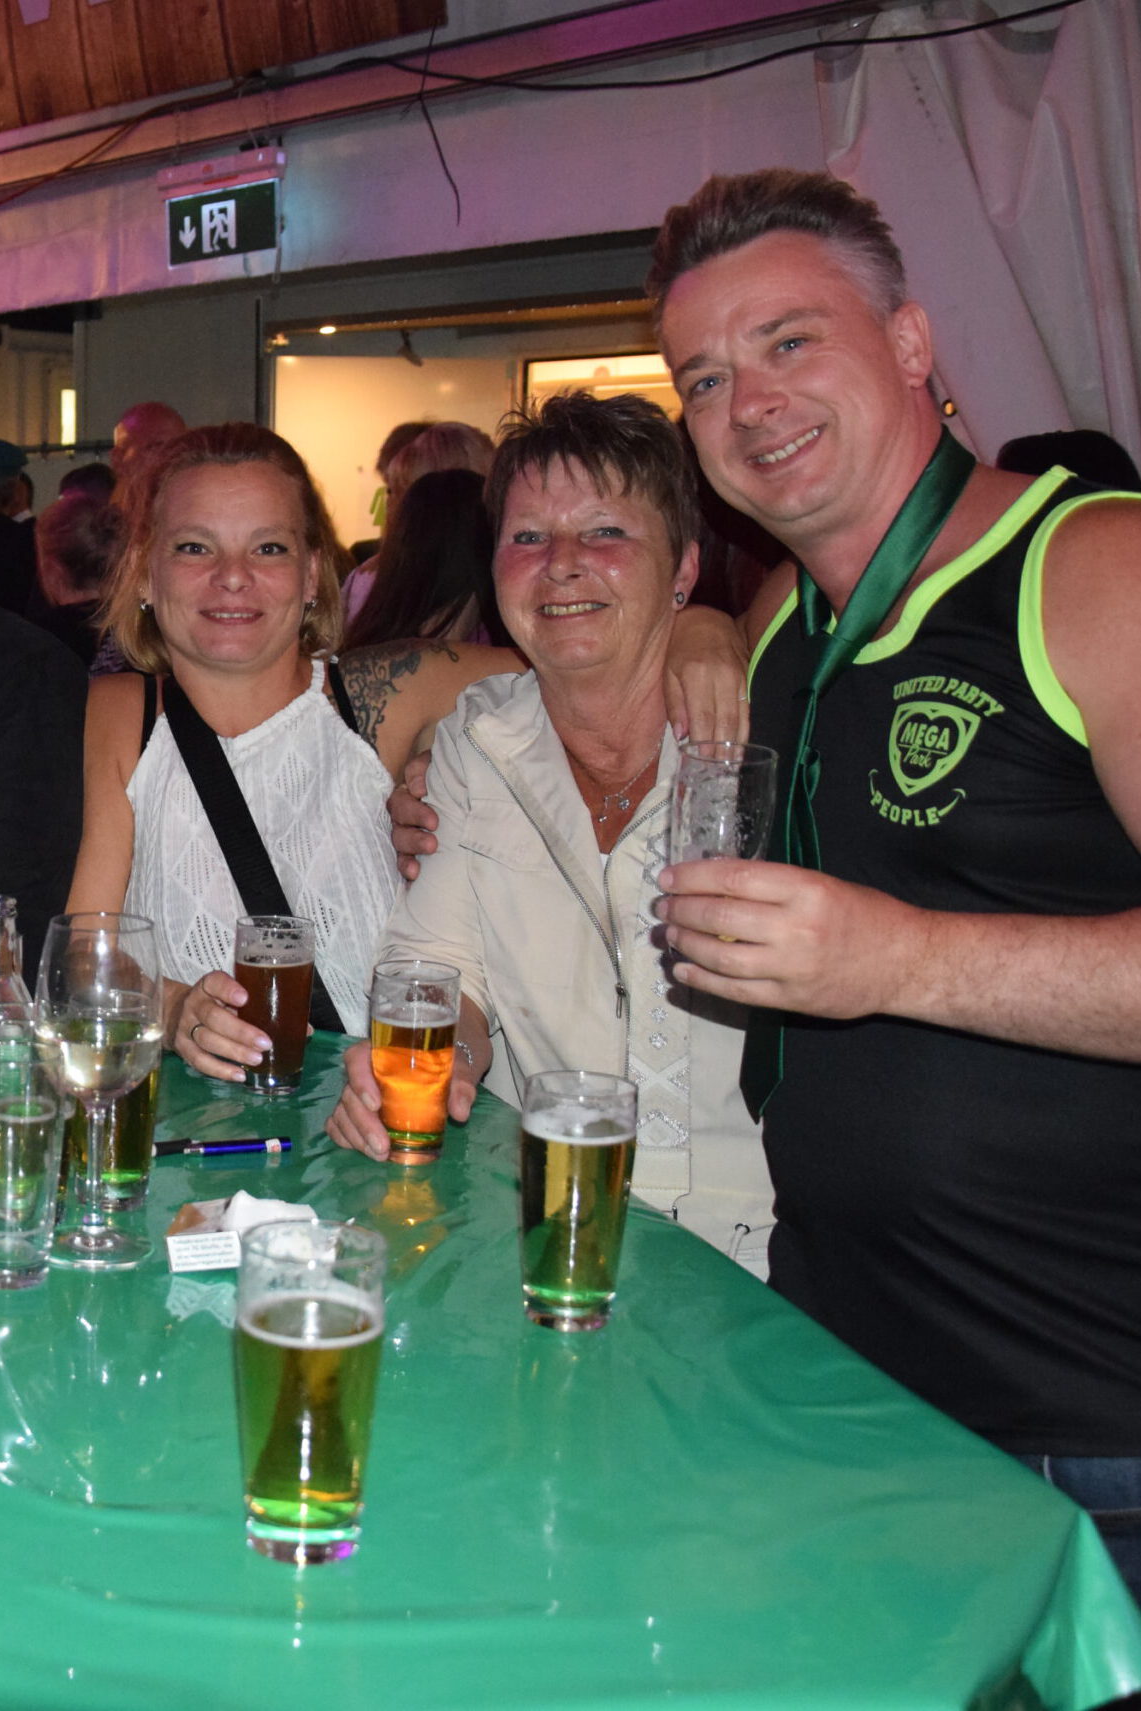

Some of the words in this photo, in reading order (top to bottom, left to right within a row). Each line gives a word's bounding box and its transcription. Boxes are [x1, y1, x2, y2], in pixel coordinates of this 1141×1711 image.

[892, 675, 946, 700] UNITED
[942, 677, 1006, 717] PARTY
[899, 721, 950, 751] MEGA
[903, 744, 933, 769] Park
[870, 790, 940, 828] PEOPLE
